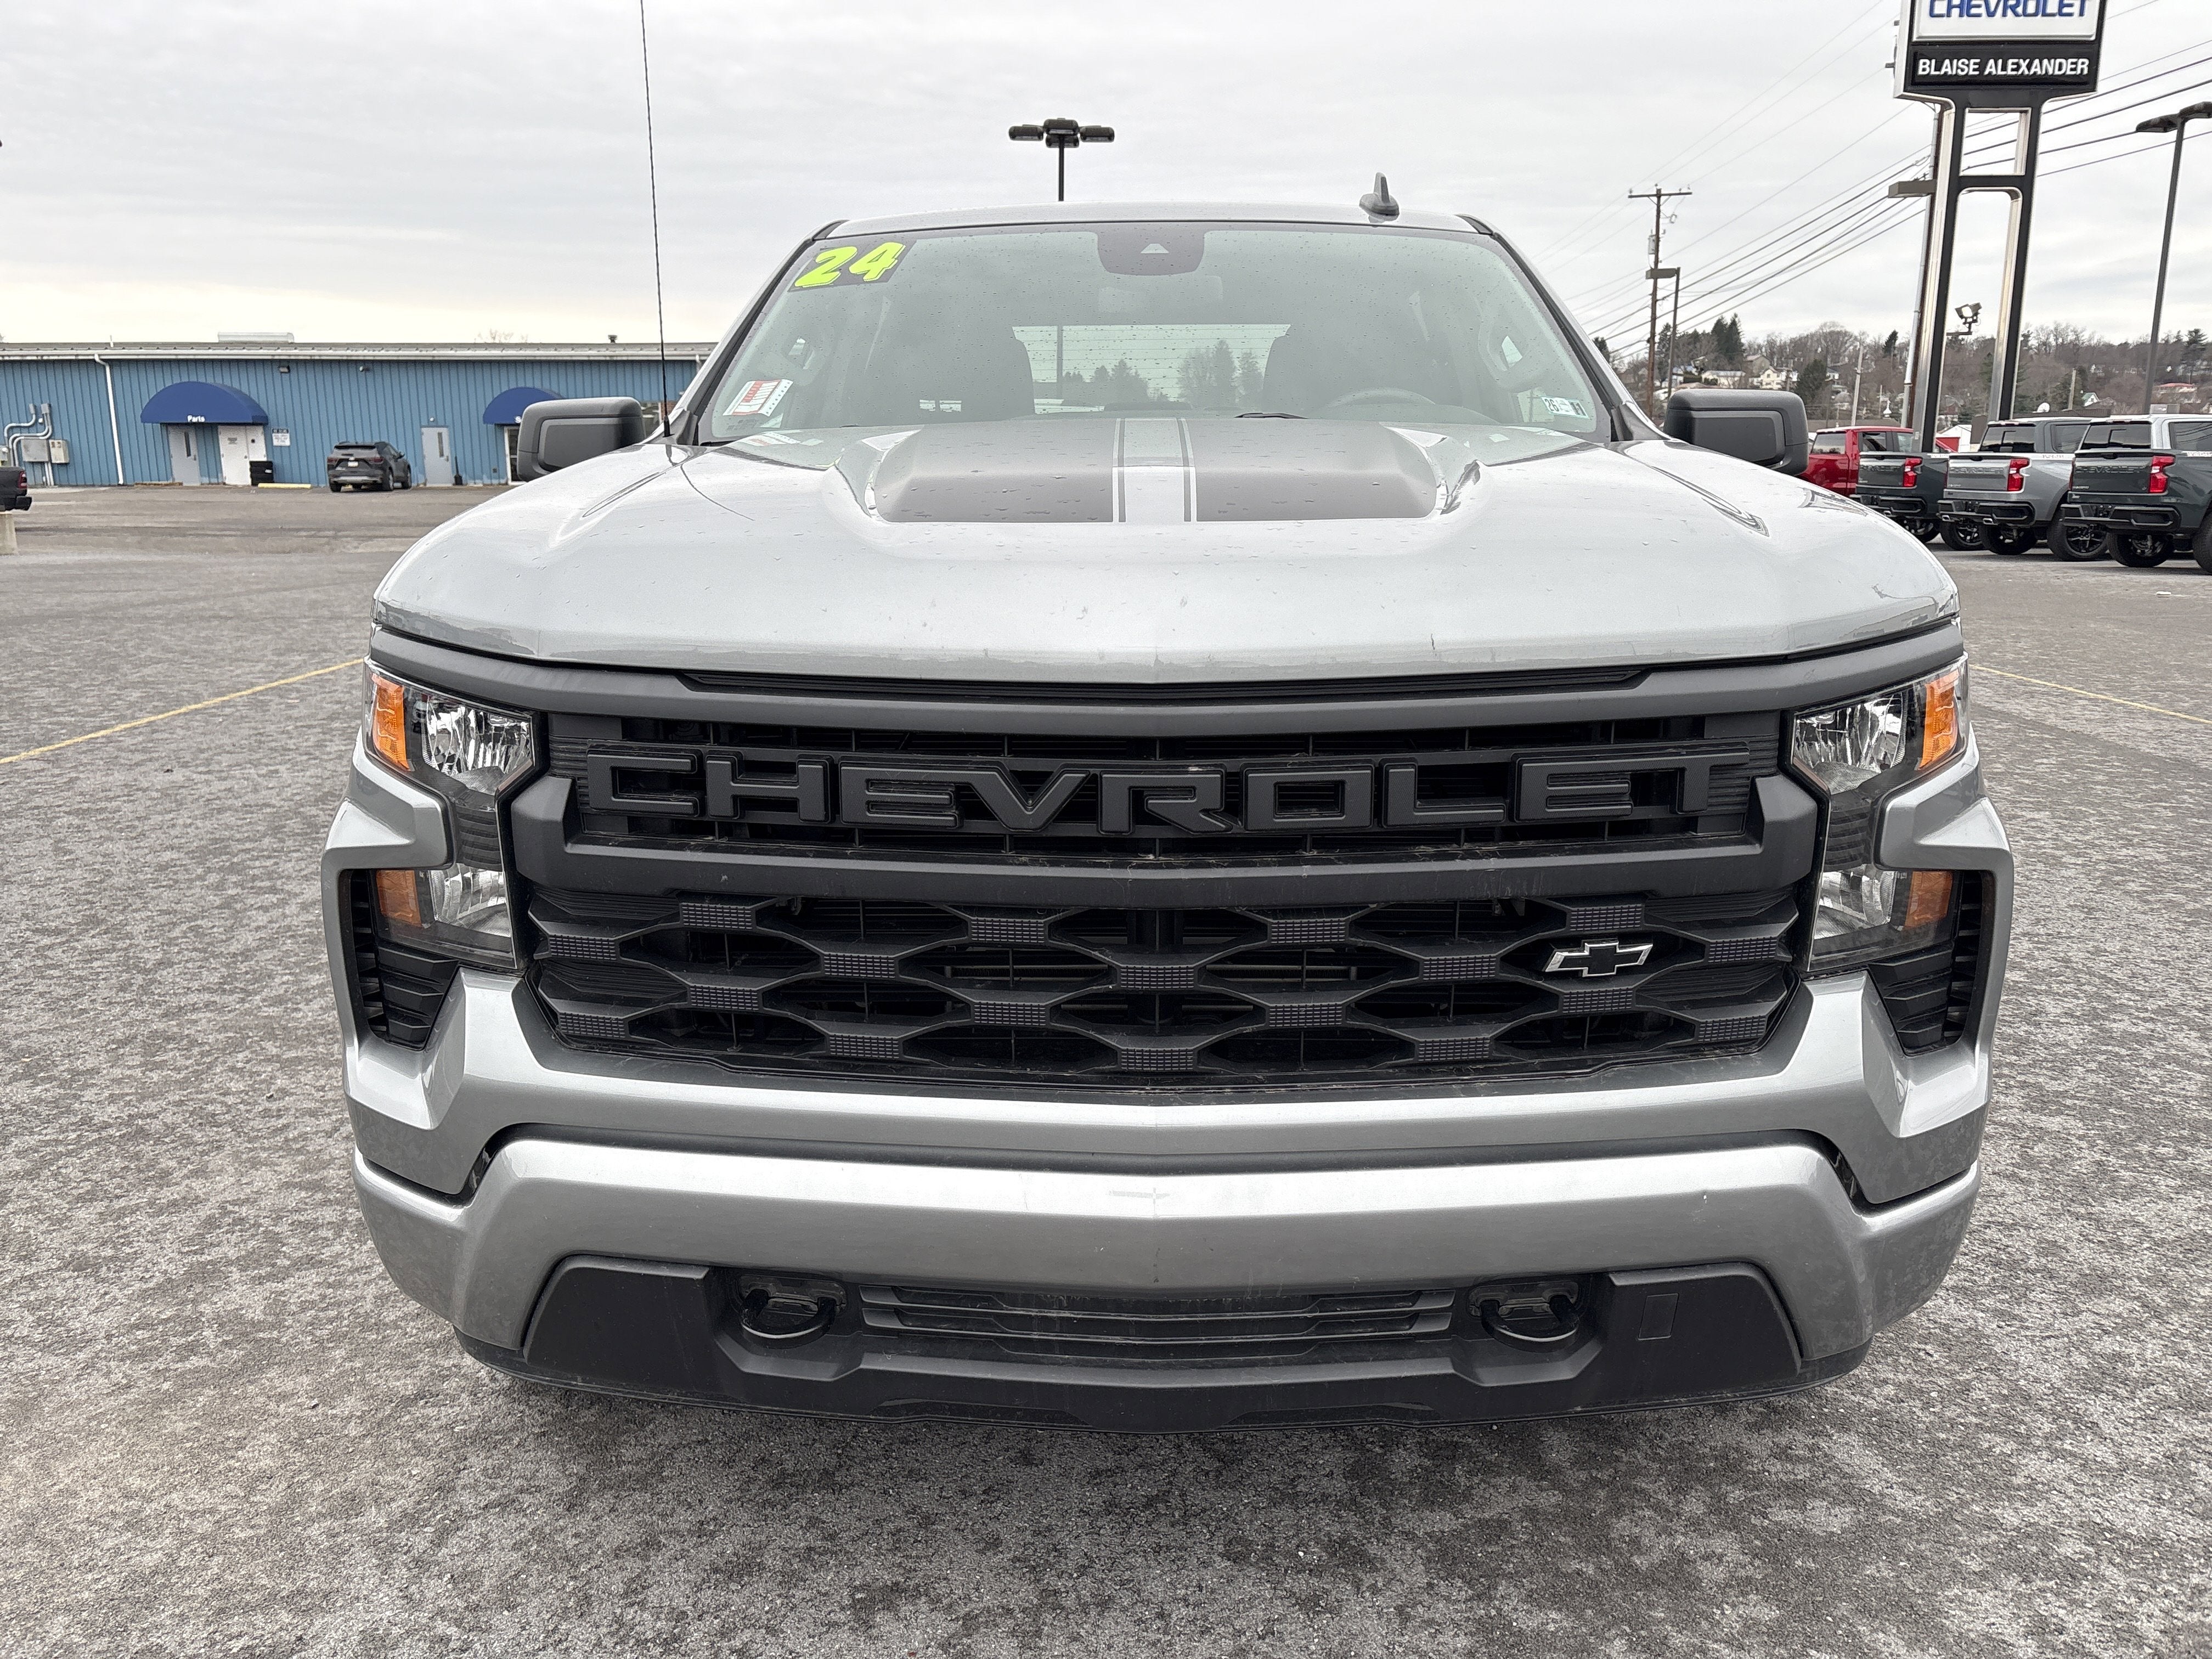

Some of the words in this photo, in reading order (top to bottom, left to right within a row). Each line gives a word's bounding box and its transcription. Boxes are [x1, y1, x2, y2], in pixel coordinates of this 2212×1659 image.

[1918, 58, 1981, 75] BLAISE
[1983, 58, 2090, 76] ALEXANDER
[794, 241, 906, 288] 24
[1544, 398, 1560, 412] 26
[587, 745, 1750, 833] CHEVROLET
